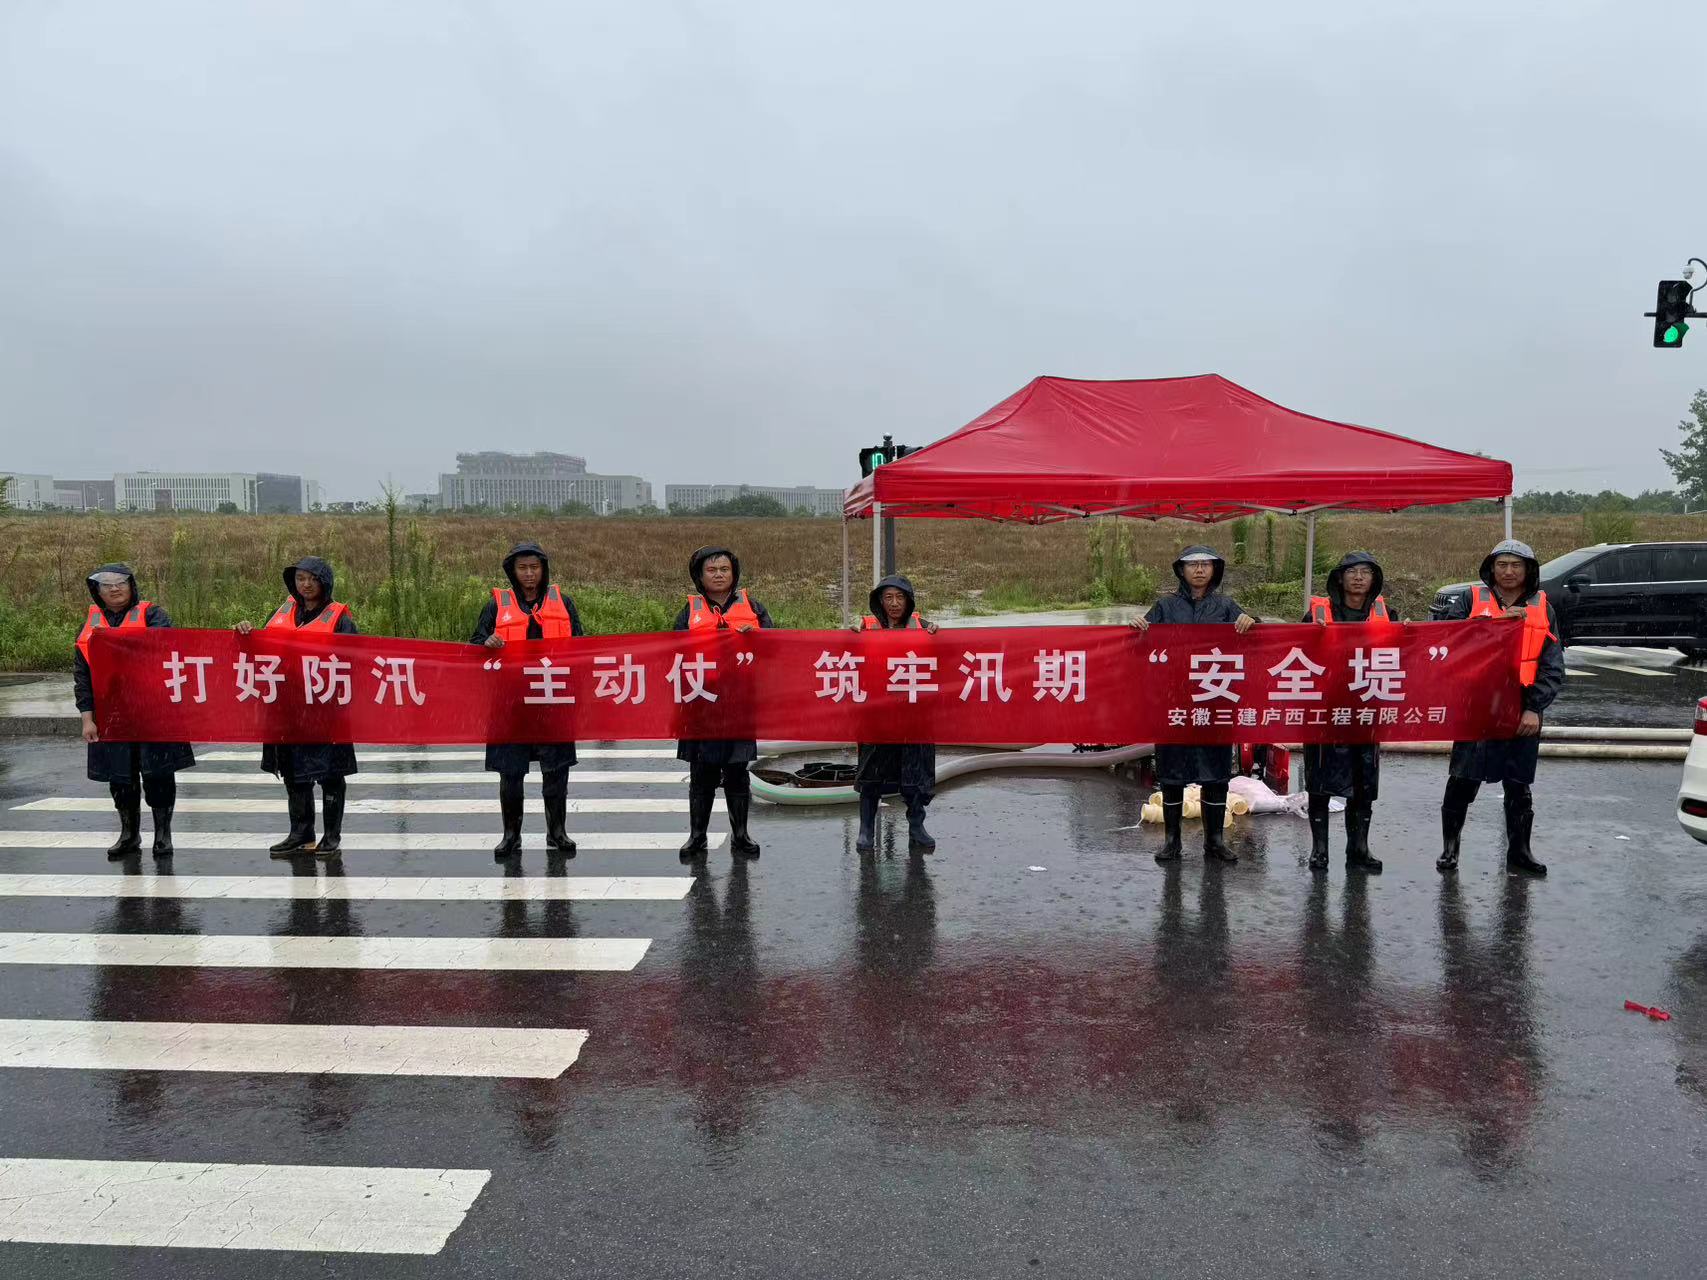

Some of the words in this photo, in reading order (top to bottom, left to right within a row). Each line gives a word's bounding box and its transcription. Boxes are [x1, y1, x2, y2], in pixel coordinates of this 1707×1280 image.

[163, 652, 426, 705] 打好防汛
[814, 650, 1087, 703] 筑牢汛期
[1168, 707, 1447, 726] 安徽三建庐西工程有限公司
